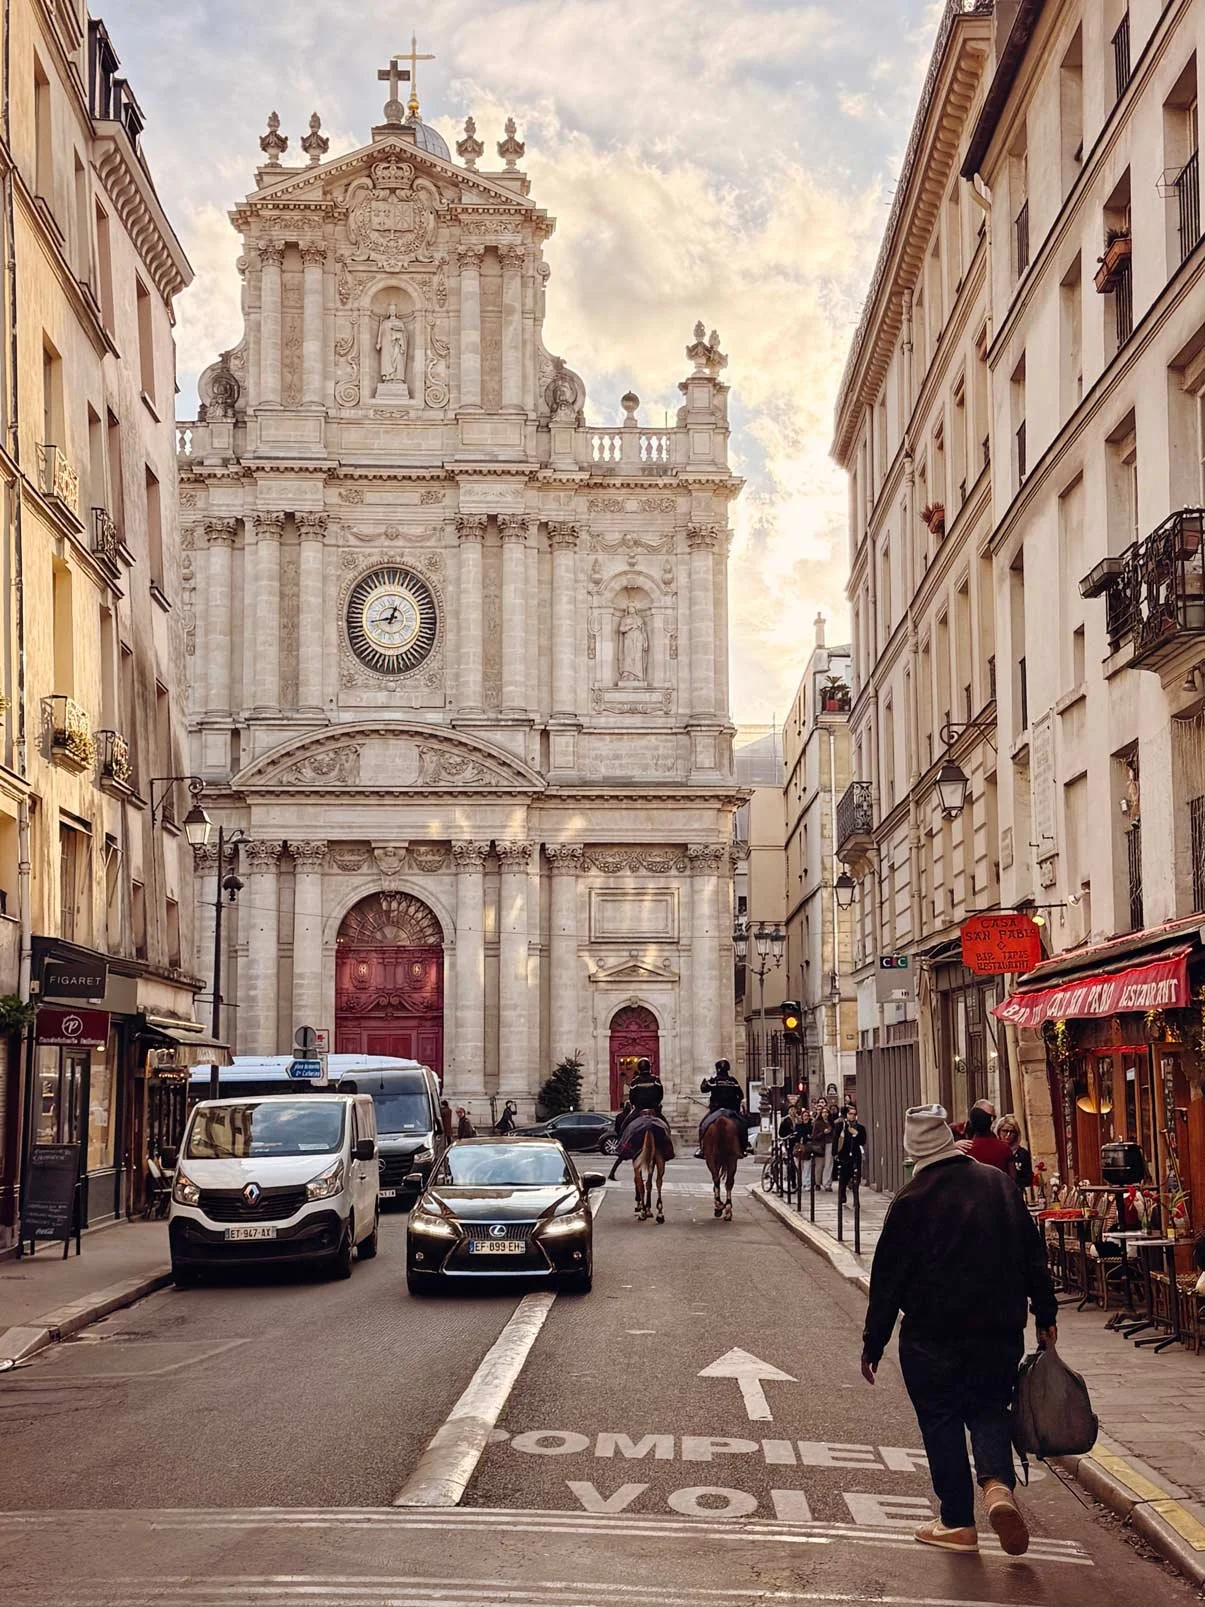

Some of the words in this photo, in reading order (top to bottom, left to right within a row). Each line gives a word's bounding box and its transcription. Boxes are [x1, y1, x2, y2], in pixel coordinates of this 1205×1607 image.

[981, 918, 1016, 929] CASA
[965, 930, 990, 942] SAN
[998, 929, 1036, 940] PABLO
[977, 959, 1029, 971] RESTAURANT
[49, 975, 102, 986] FIGARET
[565, 1480, 938, 1528] VOIE
